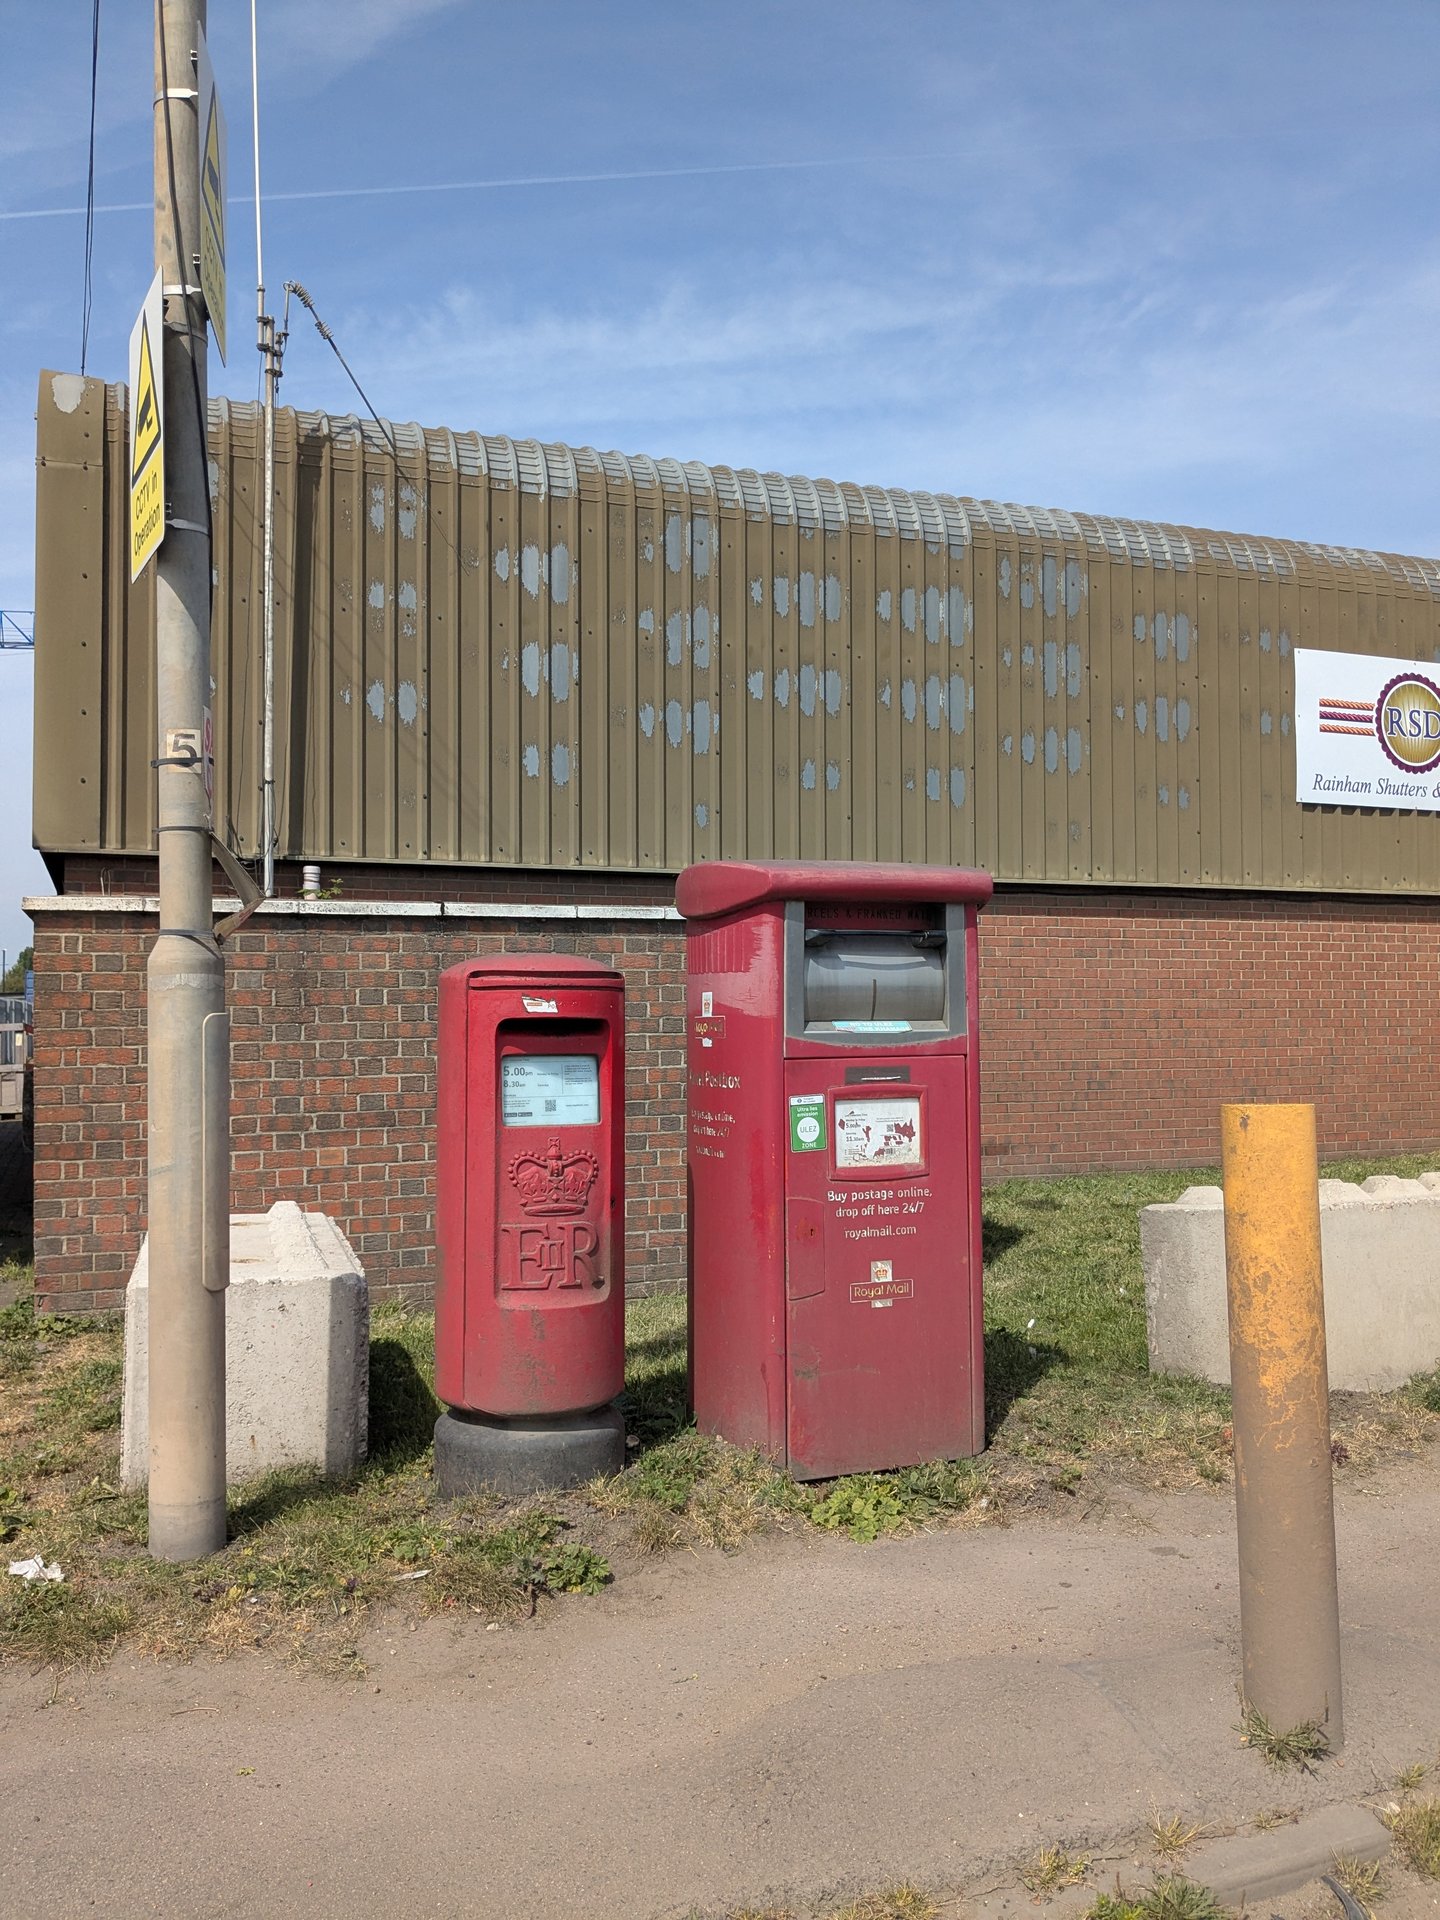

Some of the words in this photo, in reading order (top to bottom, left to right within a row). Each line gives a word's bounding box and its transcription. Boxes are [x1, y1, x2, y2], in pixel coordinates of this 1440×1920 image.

[151, 469, 158, 495] in
[134, 502, 160, 557] Operation
[1386, 707, 1440, 739] RSD
[172, 733, 198, 768] 5
[1312, 773, 1372, 794] Rainham
[1376, 777, 1428, 798] Shutters
[800, 1125, 817, 1133] ULEZ
[827, 1190, 848, 1203] Buy
[851, 1189, 894, 1203] postage
[897, 1186, 933, 1198] online,
[835, 1206, 859, 1219] drop
[861, 1204, 875, 1216] off
[878, 1204, 900, 1215] here
[902, 1200, 925, 1214] 24/7
[844, 1225, 917, 1240] royalmail.com
[854, 1284, 884, 1298] Royal
[886, 1282, 909, 1295] Mail
